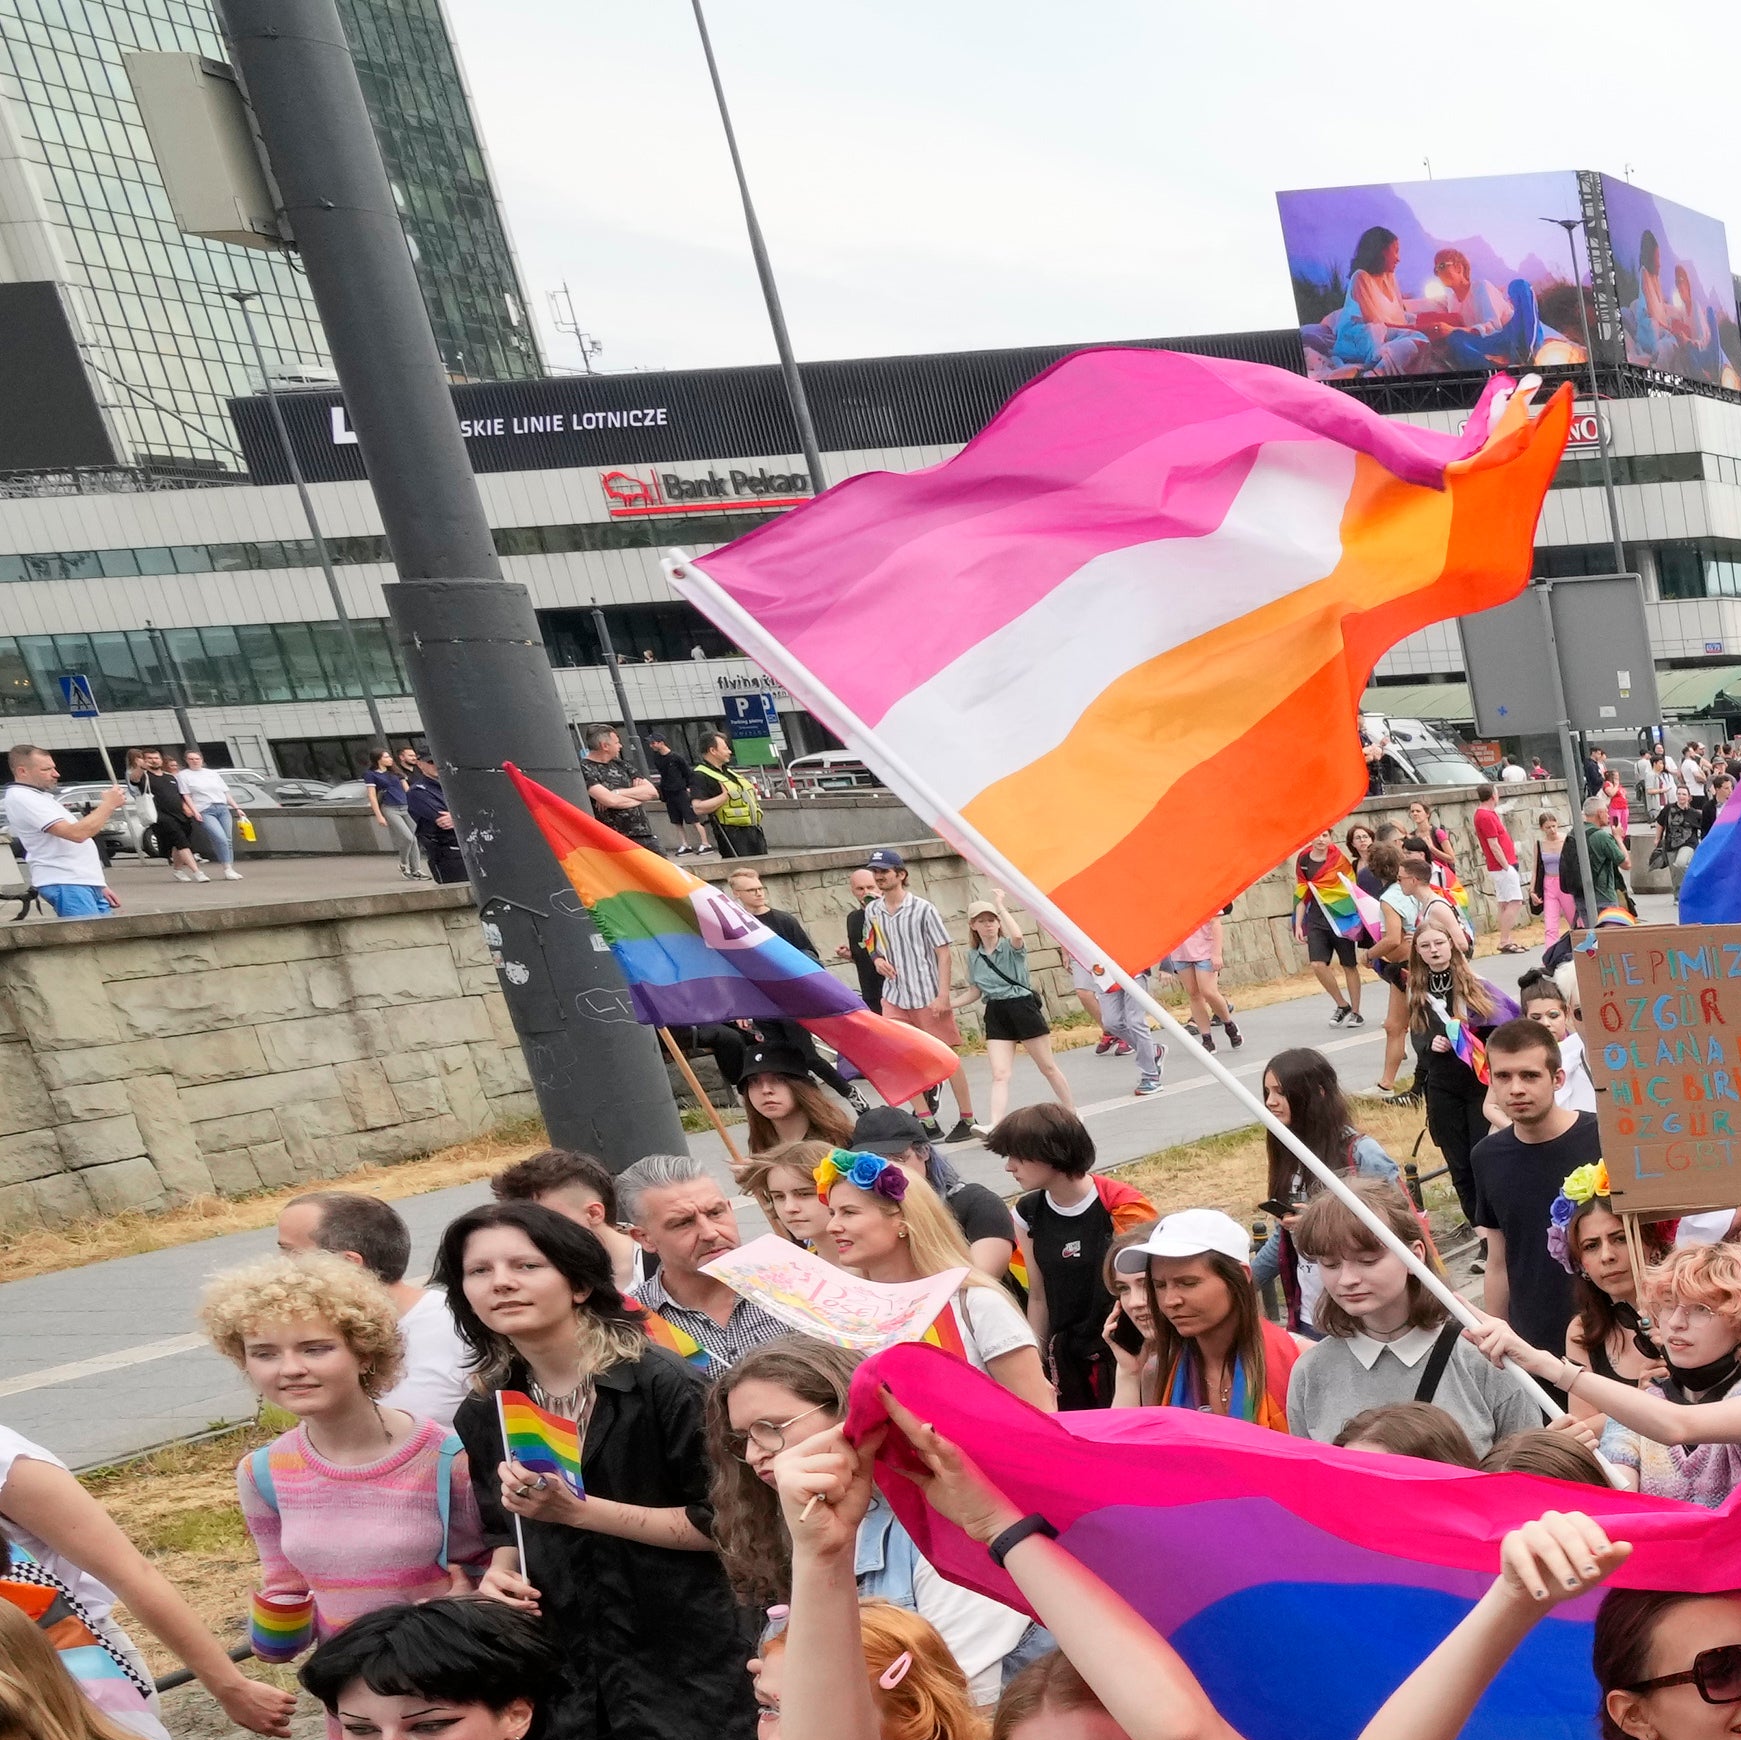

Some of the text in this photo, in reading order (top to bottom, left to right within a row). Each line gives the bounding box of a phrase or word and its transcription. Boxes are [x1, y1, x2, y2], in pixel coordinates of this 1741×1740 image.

[513, 414, 563, 435] LINIE
[572, 407, 668, 431] LOTNICZE
[662, 468, 808, 499] Bank Pekao
[735, 698, 749, 718] P
[1599, 986, 1727, 1033] ÖZGÜR
[1603, 1033, 1725, 1070] OLANA
[1617, 1105, 1736, 1139] ÖZGÜR
